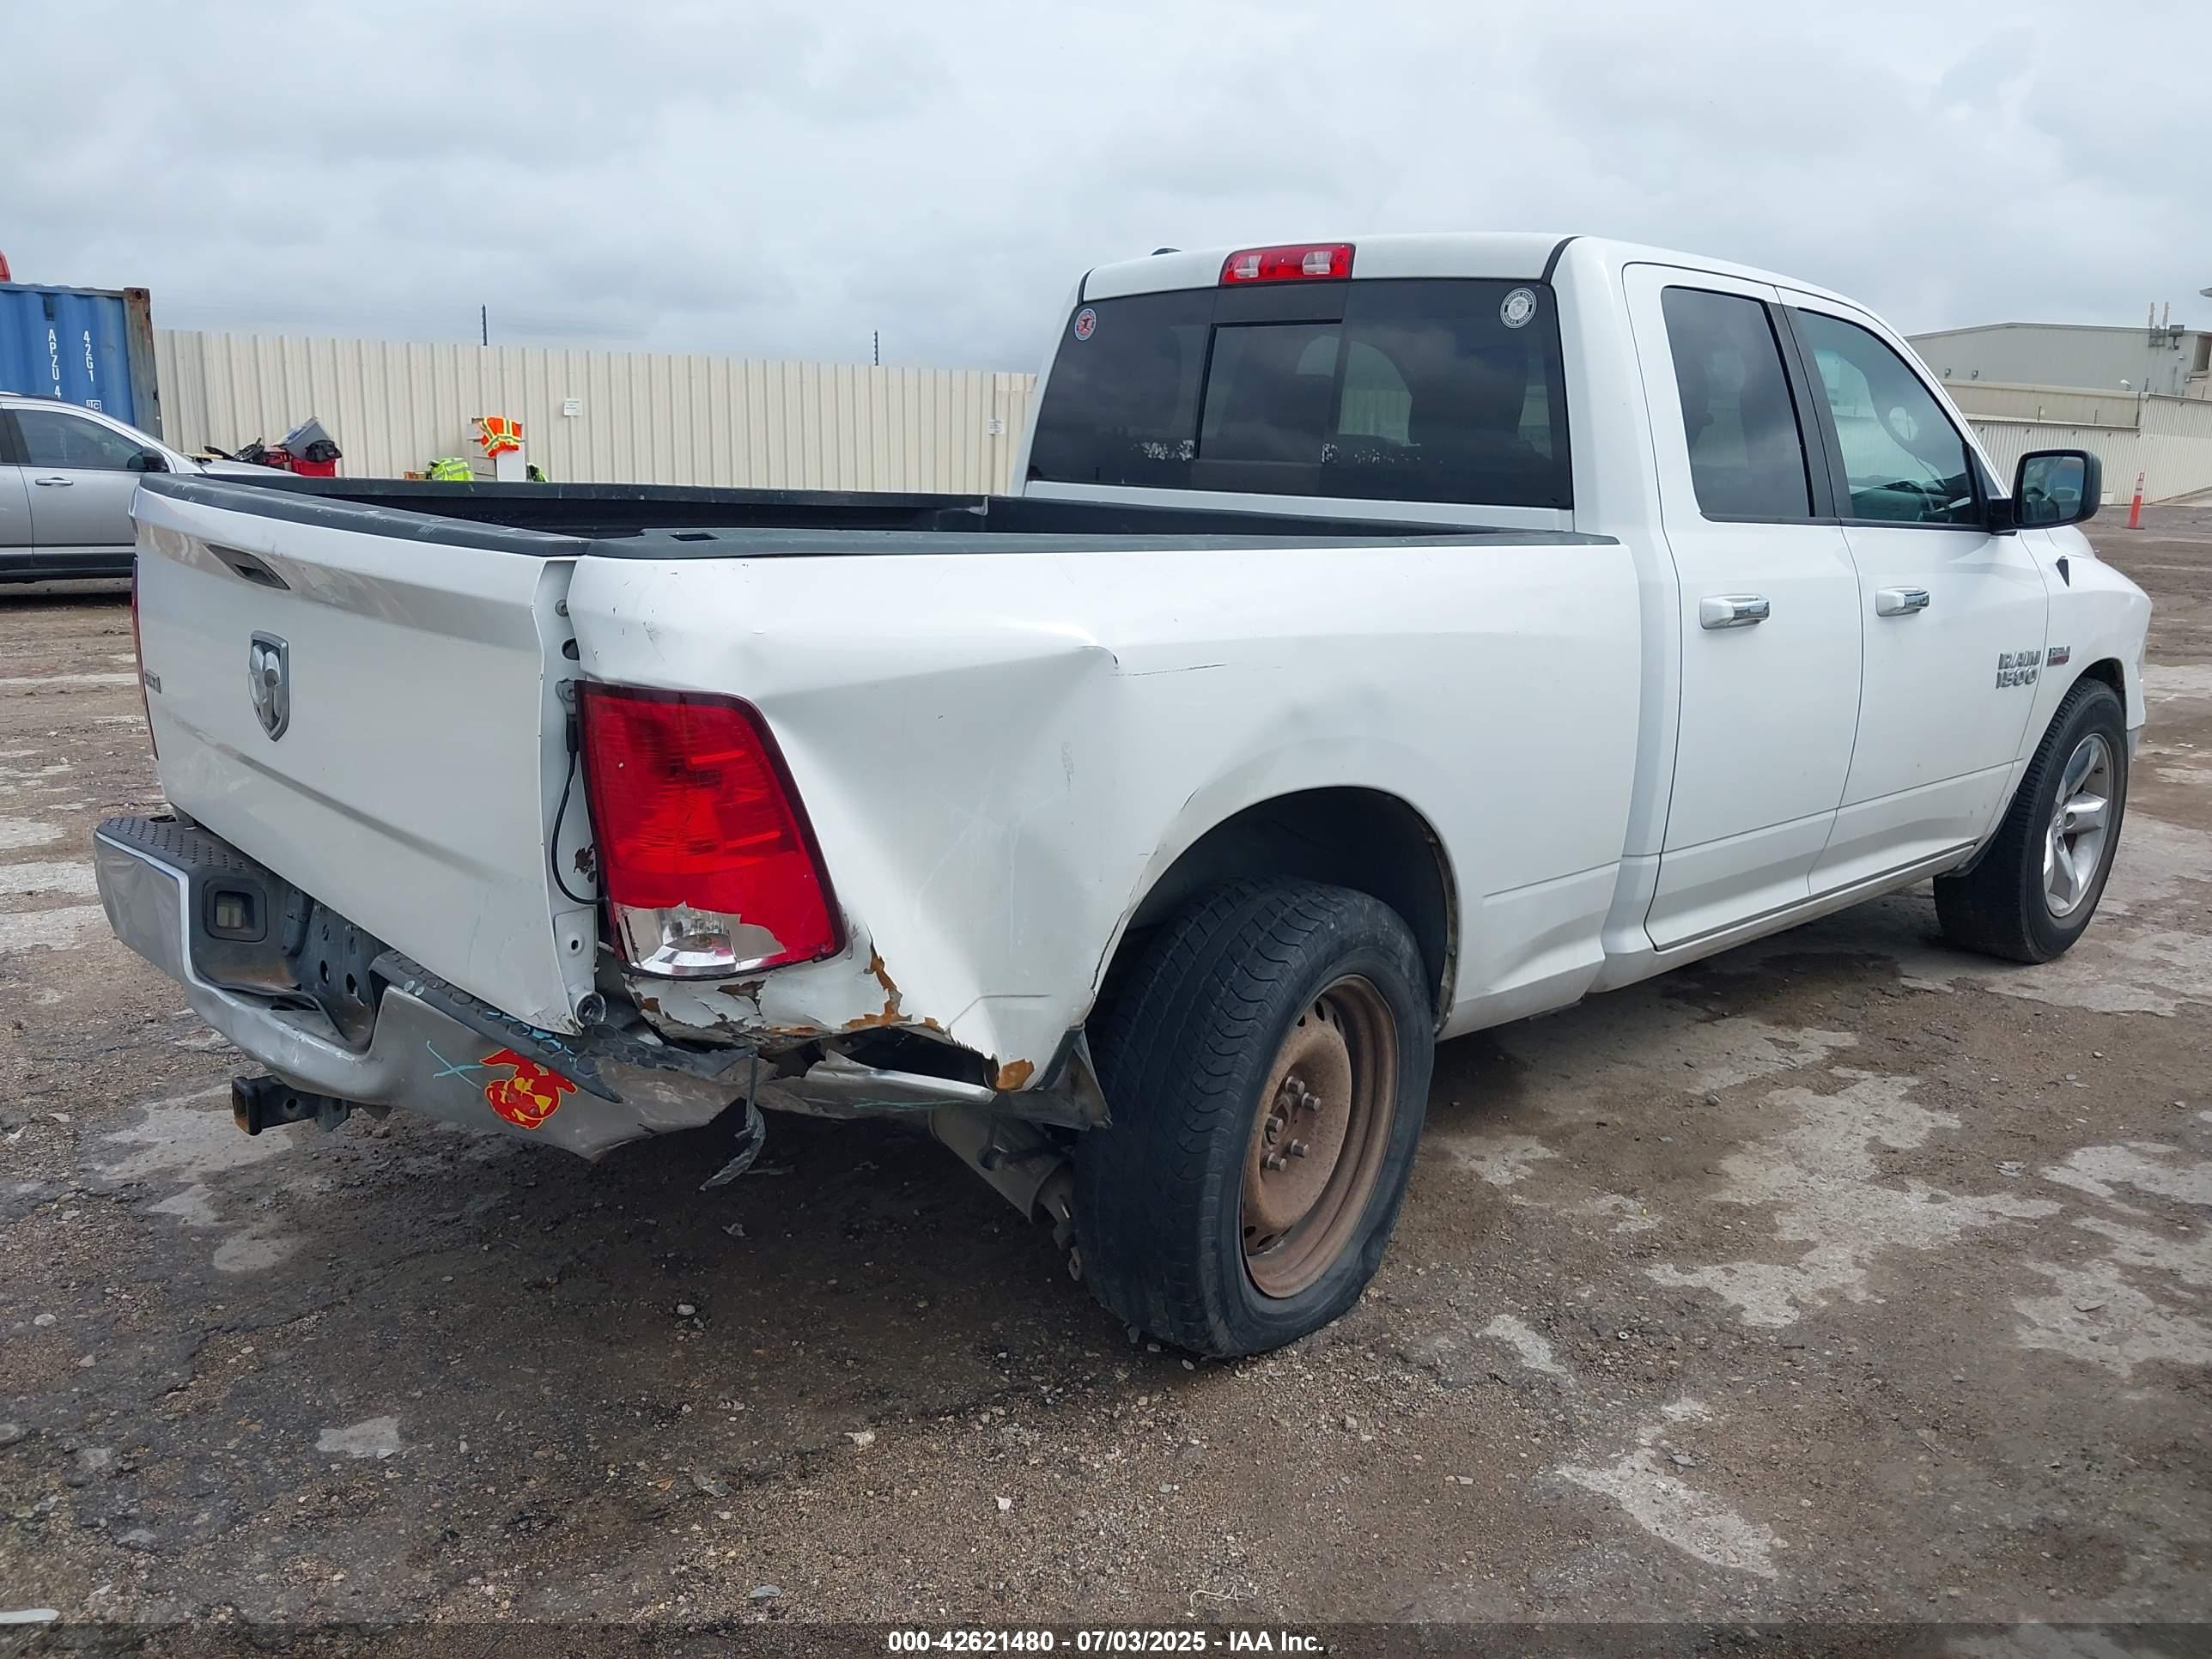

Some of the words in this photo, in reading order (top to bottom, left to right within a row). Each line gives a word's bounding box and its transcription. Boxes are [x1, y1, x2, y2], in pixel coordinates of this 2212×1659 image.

[48, 329, 60, 380] APZU
[83, 331, 94, 382] 42G1
[1998, 651, 2041, 669] RAM
